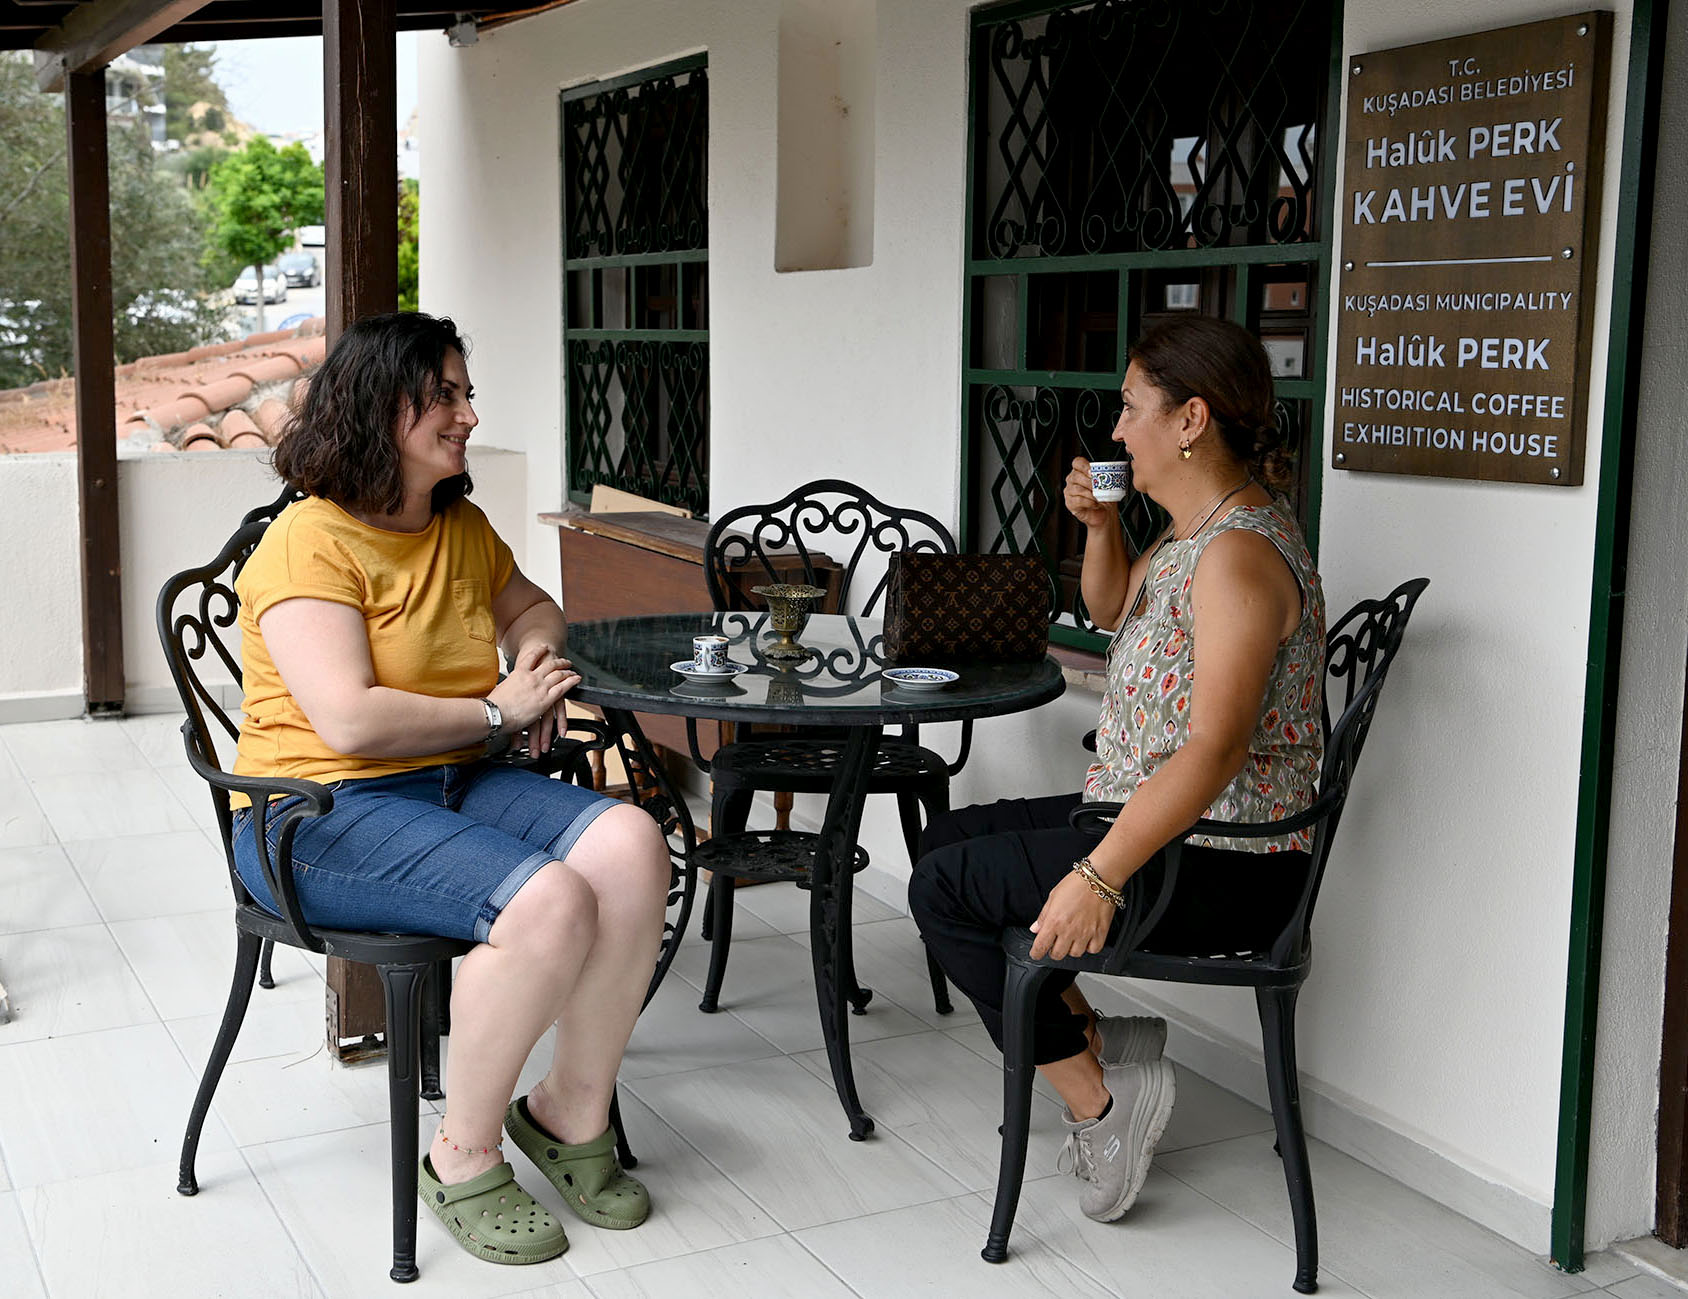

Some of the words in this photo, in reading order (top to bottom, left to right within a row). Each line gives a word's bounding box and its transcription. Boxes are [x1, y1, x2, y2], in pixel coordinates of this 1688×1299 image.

[1449, 57, 1481, 77] T.C.
[1363, 86, 1454, 117] KUŞADASI
[1460, 63, 1574, 101] BELEDİYESİ
[1366, 129, 1457, 169] Halûk
[1468, 117, 1563, 159] PERK
[1353, 181, 1491, 225] KAHVE
[1502, 161, 1575, 216] EVİ
[1345, 294, 1430, 318] KUŞADASI
[1435, 292, 1573, 311] MUNICIPALITY
[1356, 334, 1446, 368] Halûk
[1457, 337, 1551, 371] PERK
[1341, 387, 1465, 413] HISTORICAL
[1471, 392, 1565, 419] COFFEE
[1344, 422, 1465, 451] EXHIBITION
[1472, 430, 1558, 458] HOUSE
